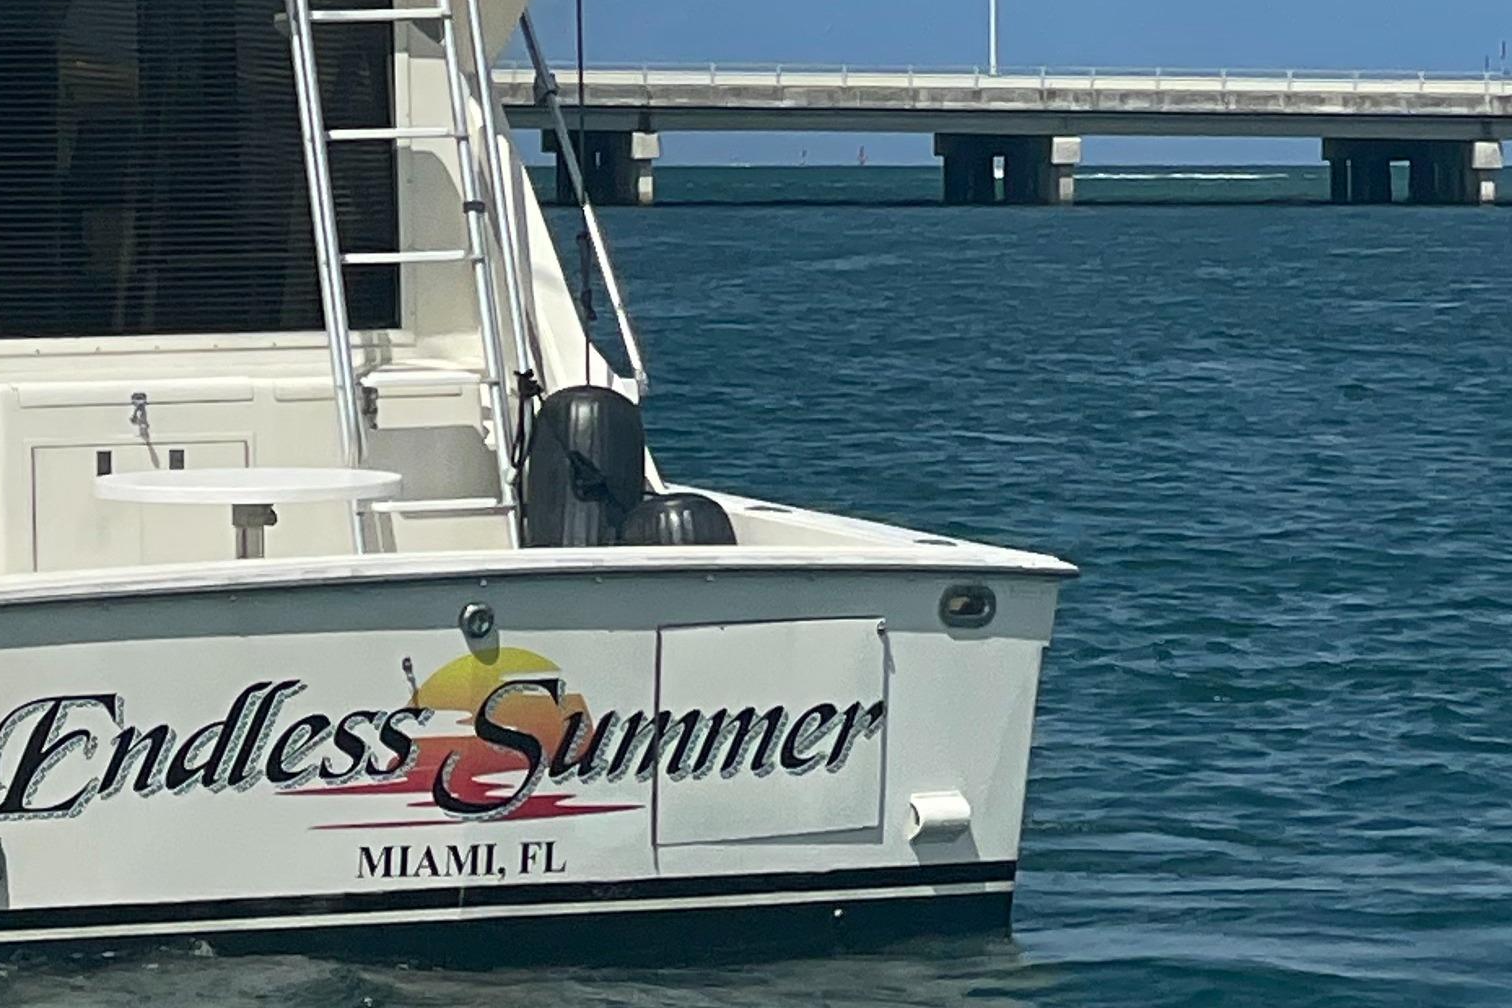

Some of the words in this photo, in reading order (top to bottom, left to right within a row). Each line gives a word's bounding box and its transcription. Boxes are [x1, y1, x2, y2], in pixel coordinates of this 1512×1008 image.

[432, 677, 885, 822] Summer
[356, 842, 506, 881] MIAMI,
[519, 841, 567, 875] FL
